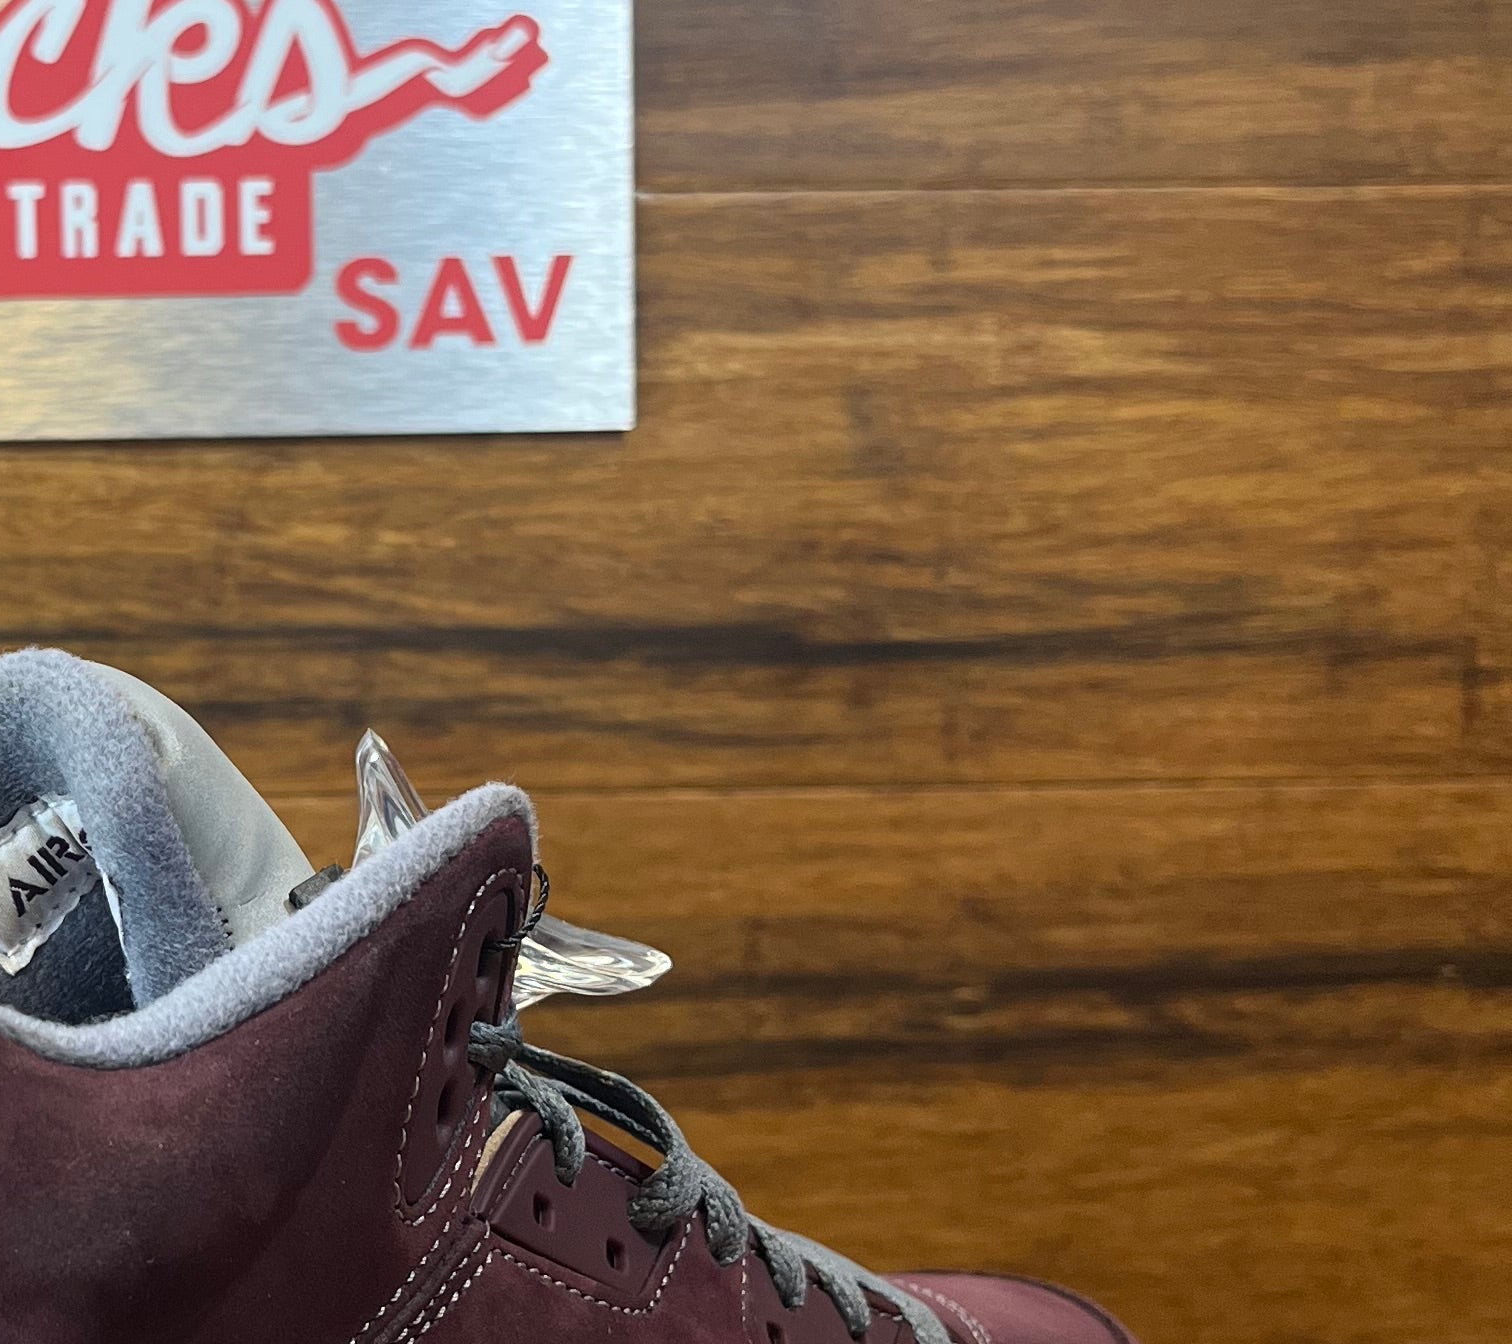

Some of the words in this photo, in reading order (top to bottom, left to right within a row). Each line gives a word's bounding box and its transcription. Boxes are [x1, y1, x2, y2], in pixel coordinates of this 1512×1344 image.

[7, 177, 277, 259] TRADE
[333, 254, 573, 352] SAV
[8, 835, 86, 918] AIR
